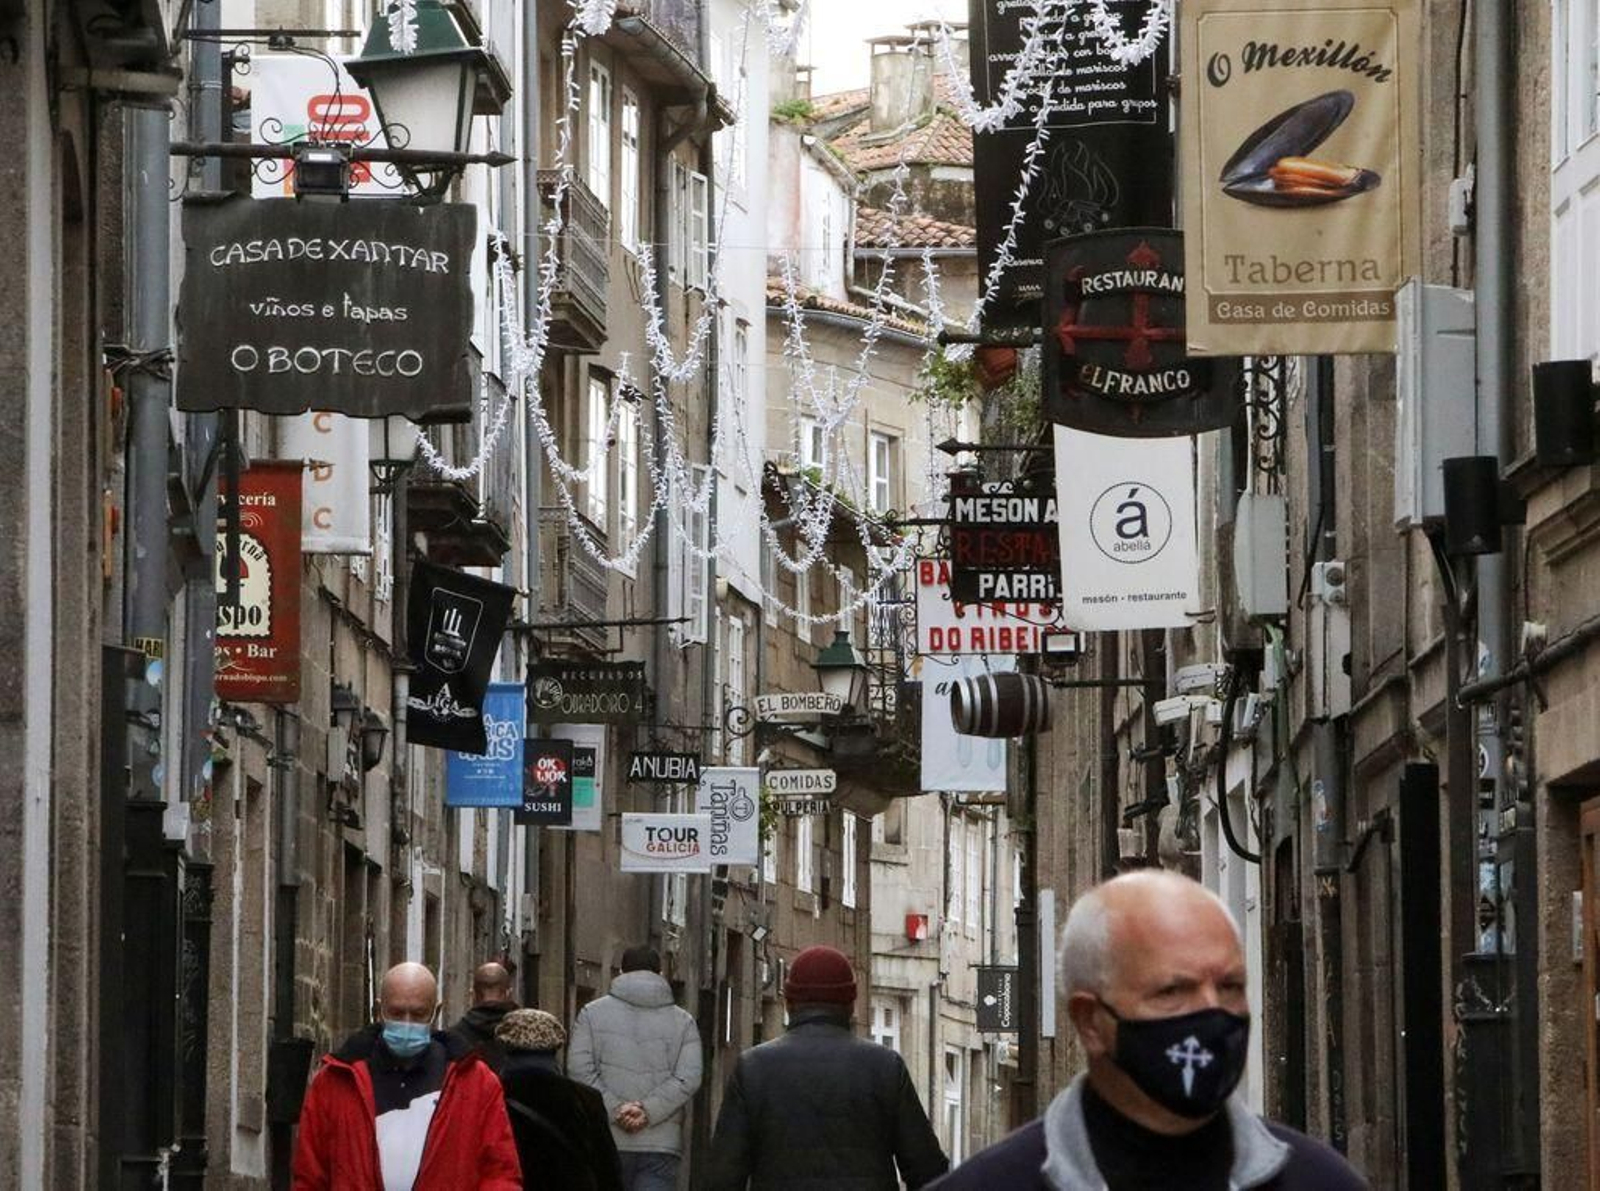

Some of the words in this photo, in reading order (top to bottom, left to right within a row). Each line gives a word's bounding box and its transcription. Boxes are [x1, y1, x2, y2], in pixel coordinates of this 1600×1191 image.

[1207, 51, 1231, 87] O
[1242, 39, 1393, 83] Mexillón
[1075, 79, 1126, 93] mariscos
[1088, 99, 1118, 116] para
[1224, 255, 1381, 284] Taberna
[322, 303, 335, 318] e
[343, 292, 408, 324] tapas
[1217, 302, 1265, 319] Casa
[1272, 302, 1296, 318] de
[1302, 299, 1390, 318] Comidas
[231, 345, 259, 371] O
[267, 346, 423, 377] BOTECO
[955, 498, 1039, 523] MESON
[1115, 487, 1149, 539] á
[1082, 594, 1118, 604] mesón
[1127, 591, 1187, 603] restaurante
[930, 627, 961, 651] DO
[247, 643, 277, 658] Bar
[757, 698, 777, 713] EL
[781, 695, 841, 712] BOMBERO
[538, 757, 557, 770] OK
[629, 756, 697, 779] ANUBIA
[769, 774, 834, 790] COMIDAS
[524, 803, 562, 813] SUSHI
[645, 827, 698, 842] TOUR
[646, 843, 699, 854] GALICIA
